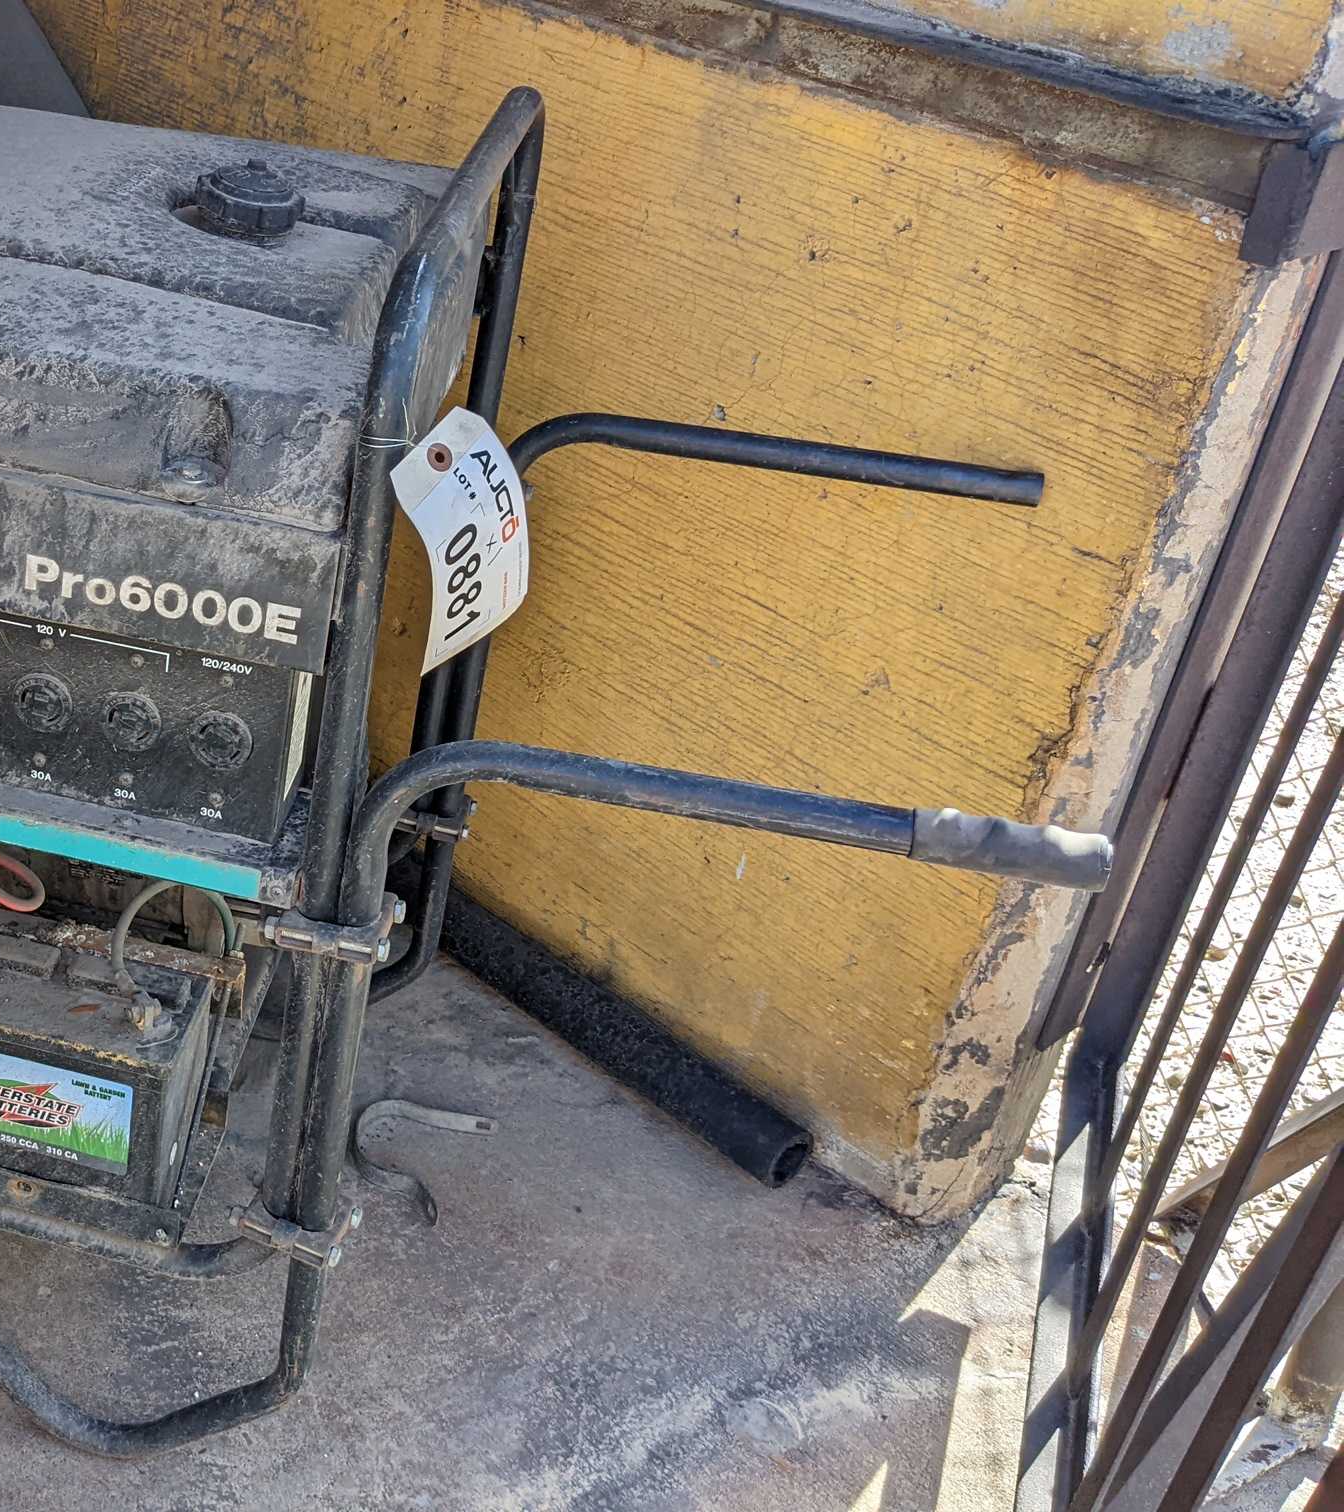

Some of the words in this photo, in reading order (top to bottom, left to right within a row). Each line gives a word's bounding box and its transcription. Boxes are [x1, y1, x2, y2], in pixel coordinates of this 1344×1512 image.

[453, 467, 472, 491] LOT
[444, 523, 481, 642] 0881
[24, 553, 302, 645] Pro6000E
[35, 624, 54, 635] 120
[58, 628, 67, 639] V
[201, 657, 253, 676] 120/240V
[30, 770, 52, 783] 30A
[113, 788, 136, 801] 30A
[200, 807, 223, 820] 30A
[18, 1139, 39, 1150] CCA
[46, 1145, 62, 1156] 310
[64, 1150, 78, 1161] CA
